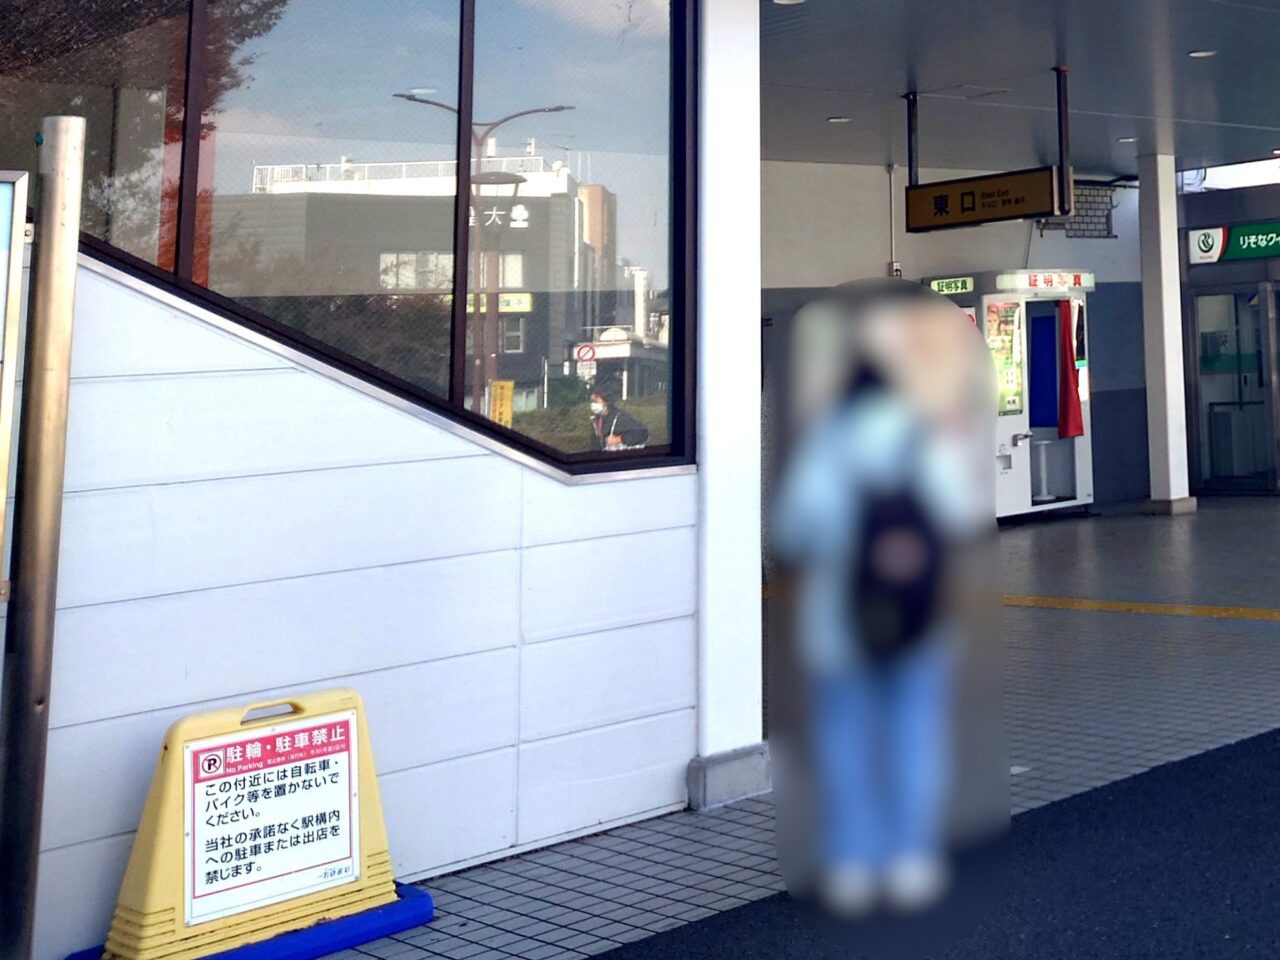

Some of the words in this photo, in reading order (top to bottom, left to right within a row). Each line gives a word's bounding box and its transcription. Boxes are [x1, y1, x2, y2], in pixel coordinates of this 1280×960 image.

[933, 191, 976, 216] 東口
[937, 278, 968, 292] 証明写真
[1028, 273, 1082, 288] 証明写真
[226, 726, 346, 764] 駐輪・駐車禁止
[227, 766, 236, 775] No
[238, 761, 263, 773] Parking
[206, 773, 341, 813] バイク等を置かないで
[206, 807, 261, 828] ください。
[205, 810, 341, 853] 当社の承諾なく駅構内
[205, 825, 341, 865] への駐車または出店を
[205, 862, 262, 885] 禁じます。
[323, 866, 350, 879] TOBU
